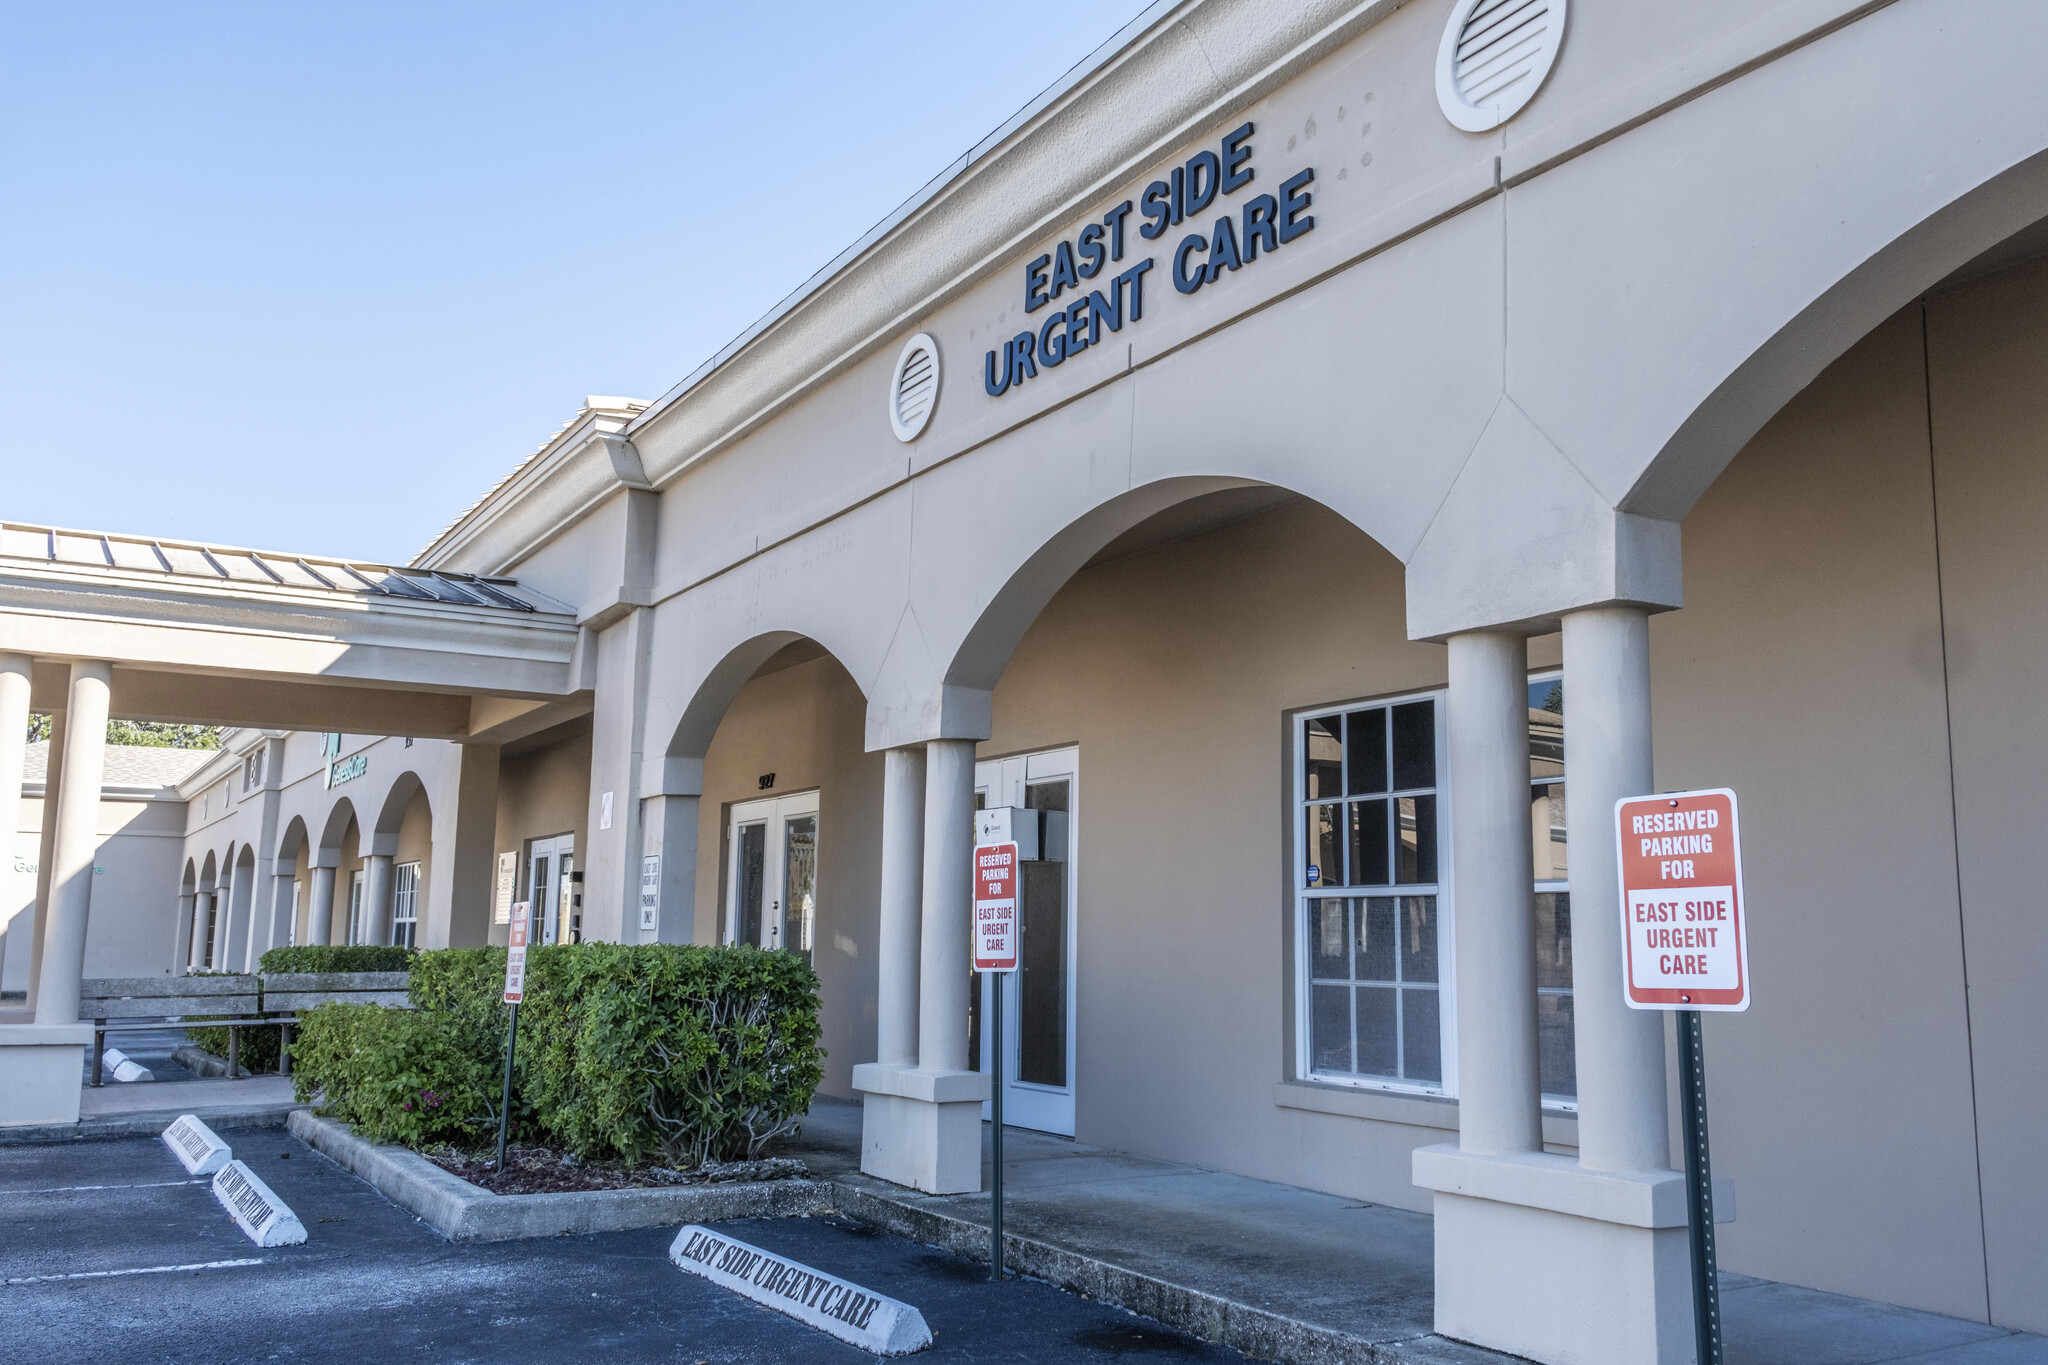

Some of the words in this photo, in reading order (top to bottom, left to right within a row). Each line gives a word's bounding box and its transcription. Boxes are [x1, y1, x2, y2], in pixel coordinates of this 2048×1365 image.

[1025, 200, 1133, 313] EAST
[1139, 121, 1254, 240] SIDE
[985, 257, 1153, 397] URGENT
[1172, 167, 1314, 295] CARE
[758, 772, 776, 790] 927
[1633, 809, 1719, 834] RESERVED
[1641, 834, 1713, 857] PARKING
[979, 853, 1012, 867] RESERVED
[1661, 859, 1695, 880] FOR
[982, 867, 1009, 881] PARKING
[988, 882, 1002, 895] FOR
[978, 907, 996, 920] EAST
[996, 907, 1012, 919] SIDE
[1635, 902, 1678, 923] EAST
[1685, 900, 1727, 922] SIDE
[982, 923, 1009, 935] URGENT
[1646, 927, 1718, 949] URGENT
[986, 938, 1004, 951] CARE
[1659, 954, 1708, 975] CARE
[216, 1163, 239, 1188] EAST
[224, 1172, 248, 1199] SIDE
[232, 1182, 263, 1218] URGENT
[246, 1200, 274, 1230] CARE
[681, 1231, 726, 1266] EAST
[715, 1245, 762, 1280] SIDE
[753, 1258, 831, 1308] URGENT
[820, 1284, 881, 1331] CARE
